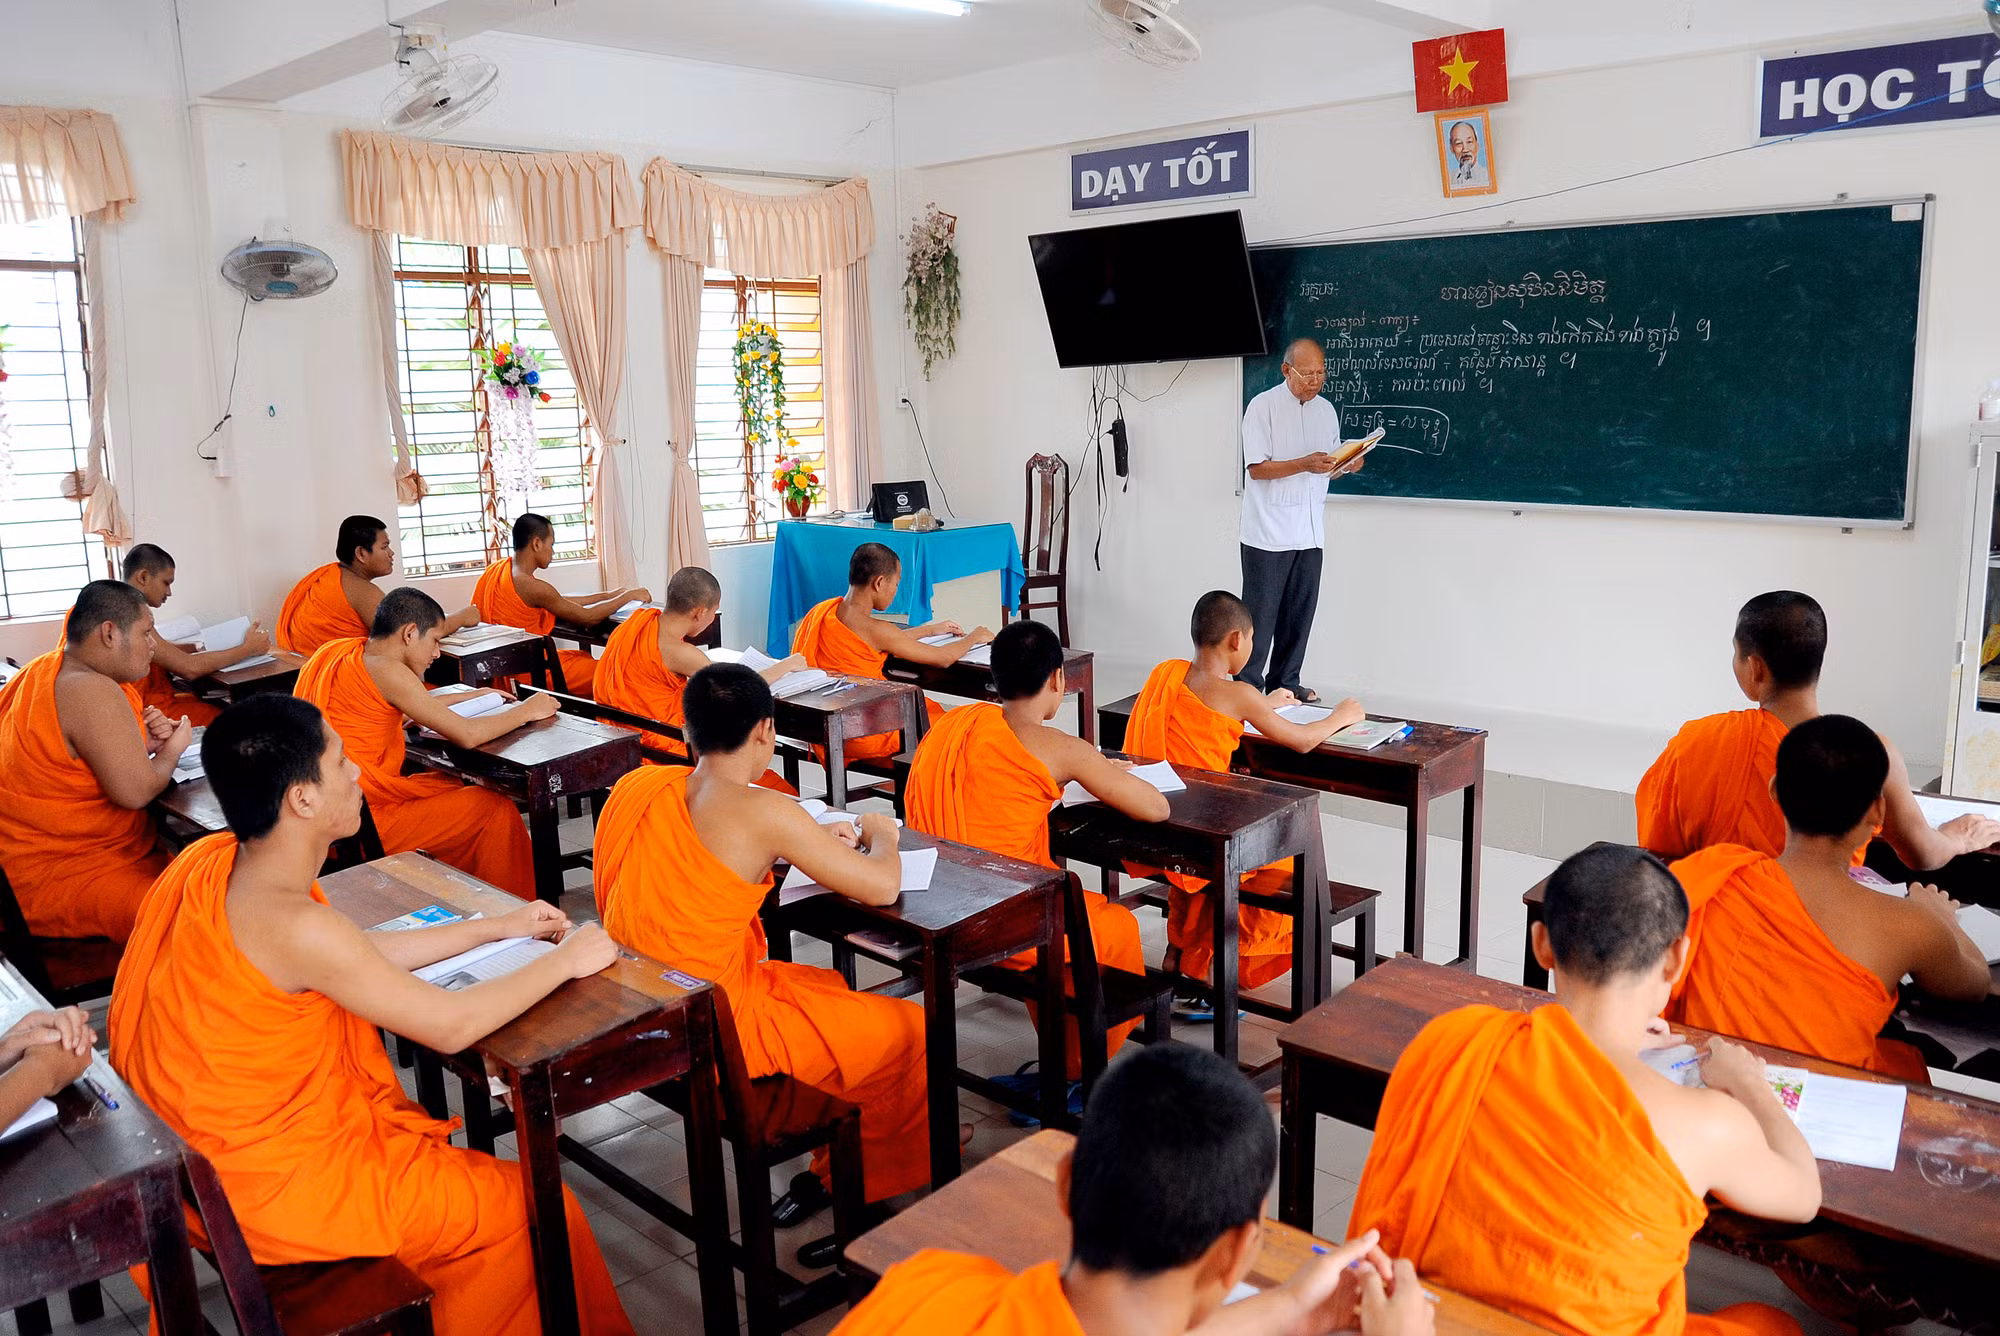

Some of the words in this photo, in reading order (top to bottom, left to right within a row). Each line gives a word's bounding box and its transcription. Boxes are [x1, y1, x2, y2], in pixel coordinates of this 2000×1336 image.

[1779, 68, 1915, 123] HỌC
[1081, 162, 1152, 201] DẠY
[1163, 141, 1238, 188] TỐT
